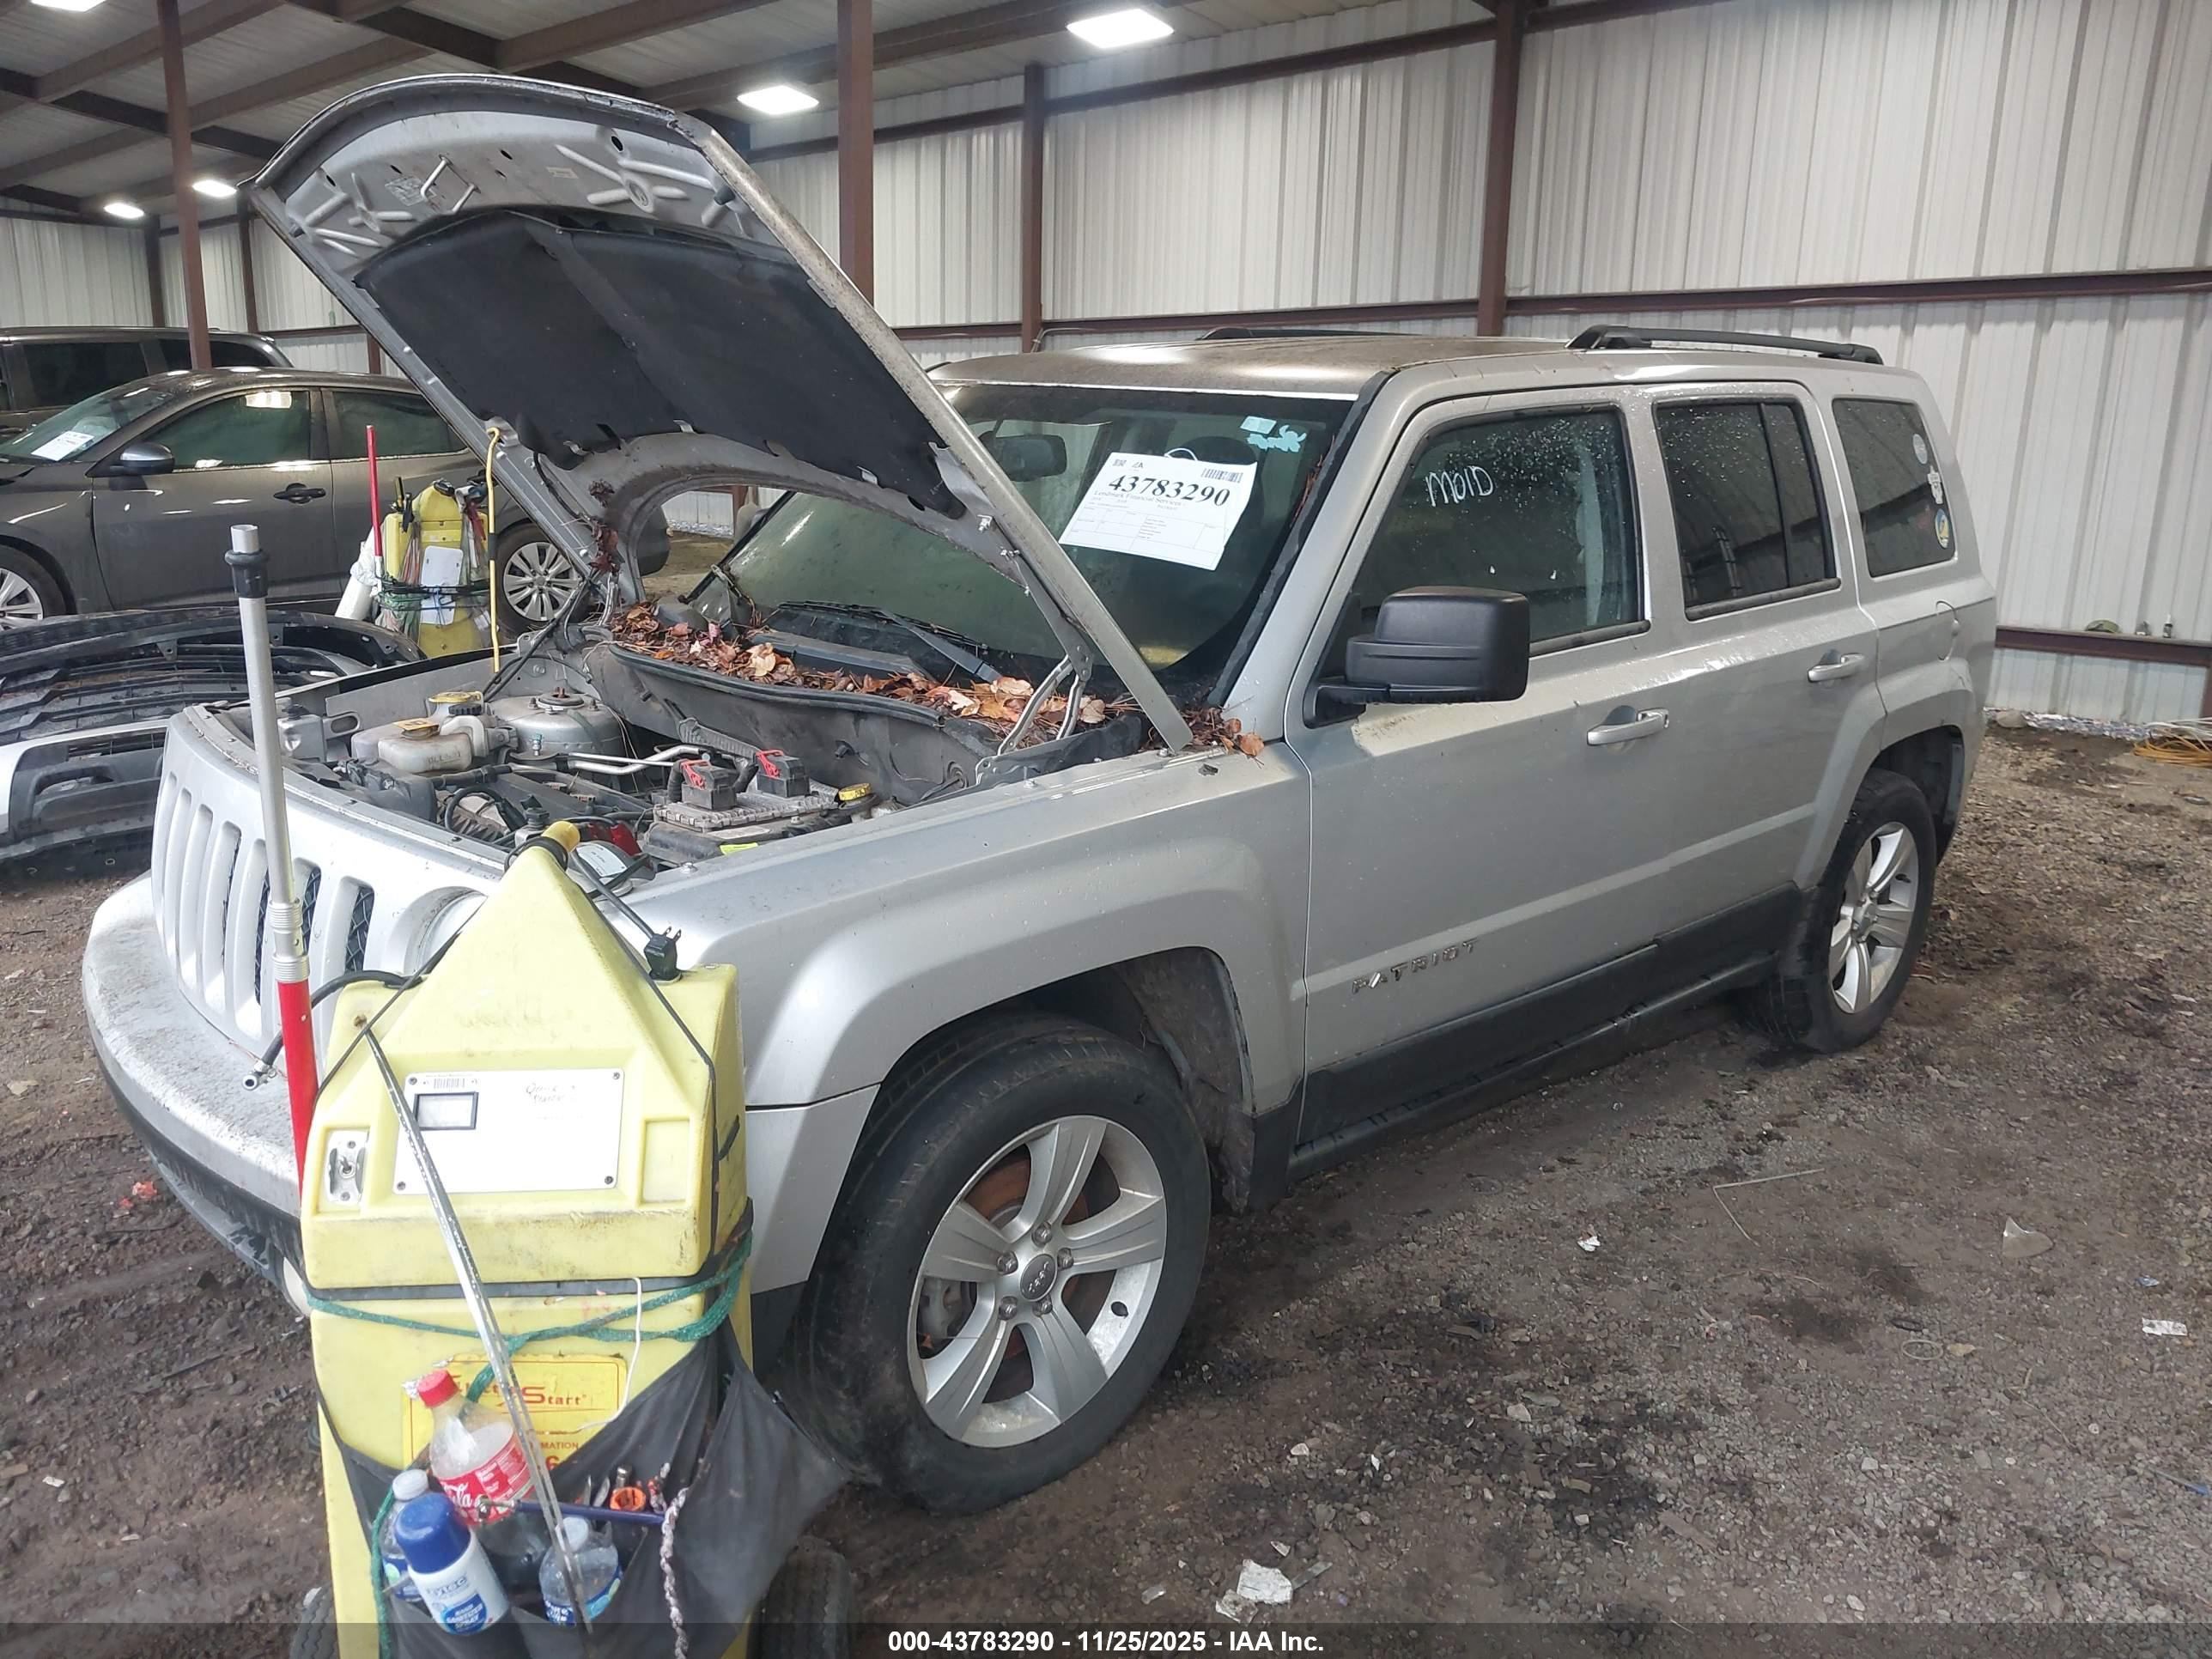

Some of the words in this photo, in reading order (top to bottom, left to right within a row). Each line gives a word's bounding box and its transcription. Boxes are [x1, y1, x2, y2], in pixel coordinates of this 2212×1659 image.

[1108, 475, 1231, 507] 43783290
[1352, 937, 1478, 994] PATRIOT
[521, 1385, 582, 1407] Start
